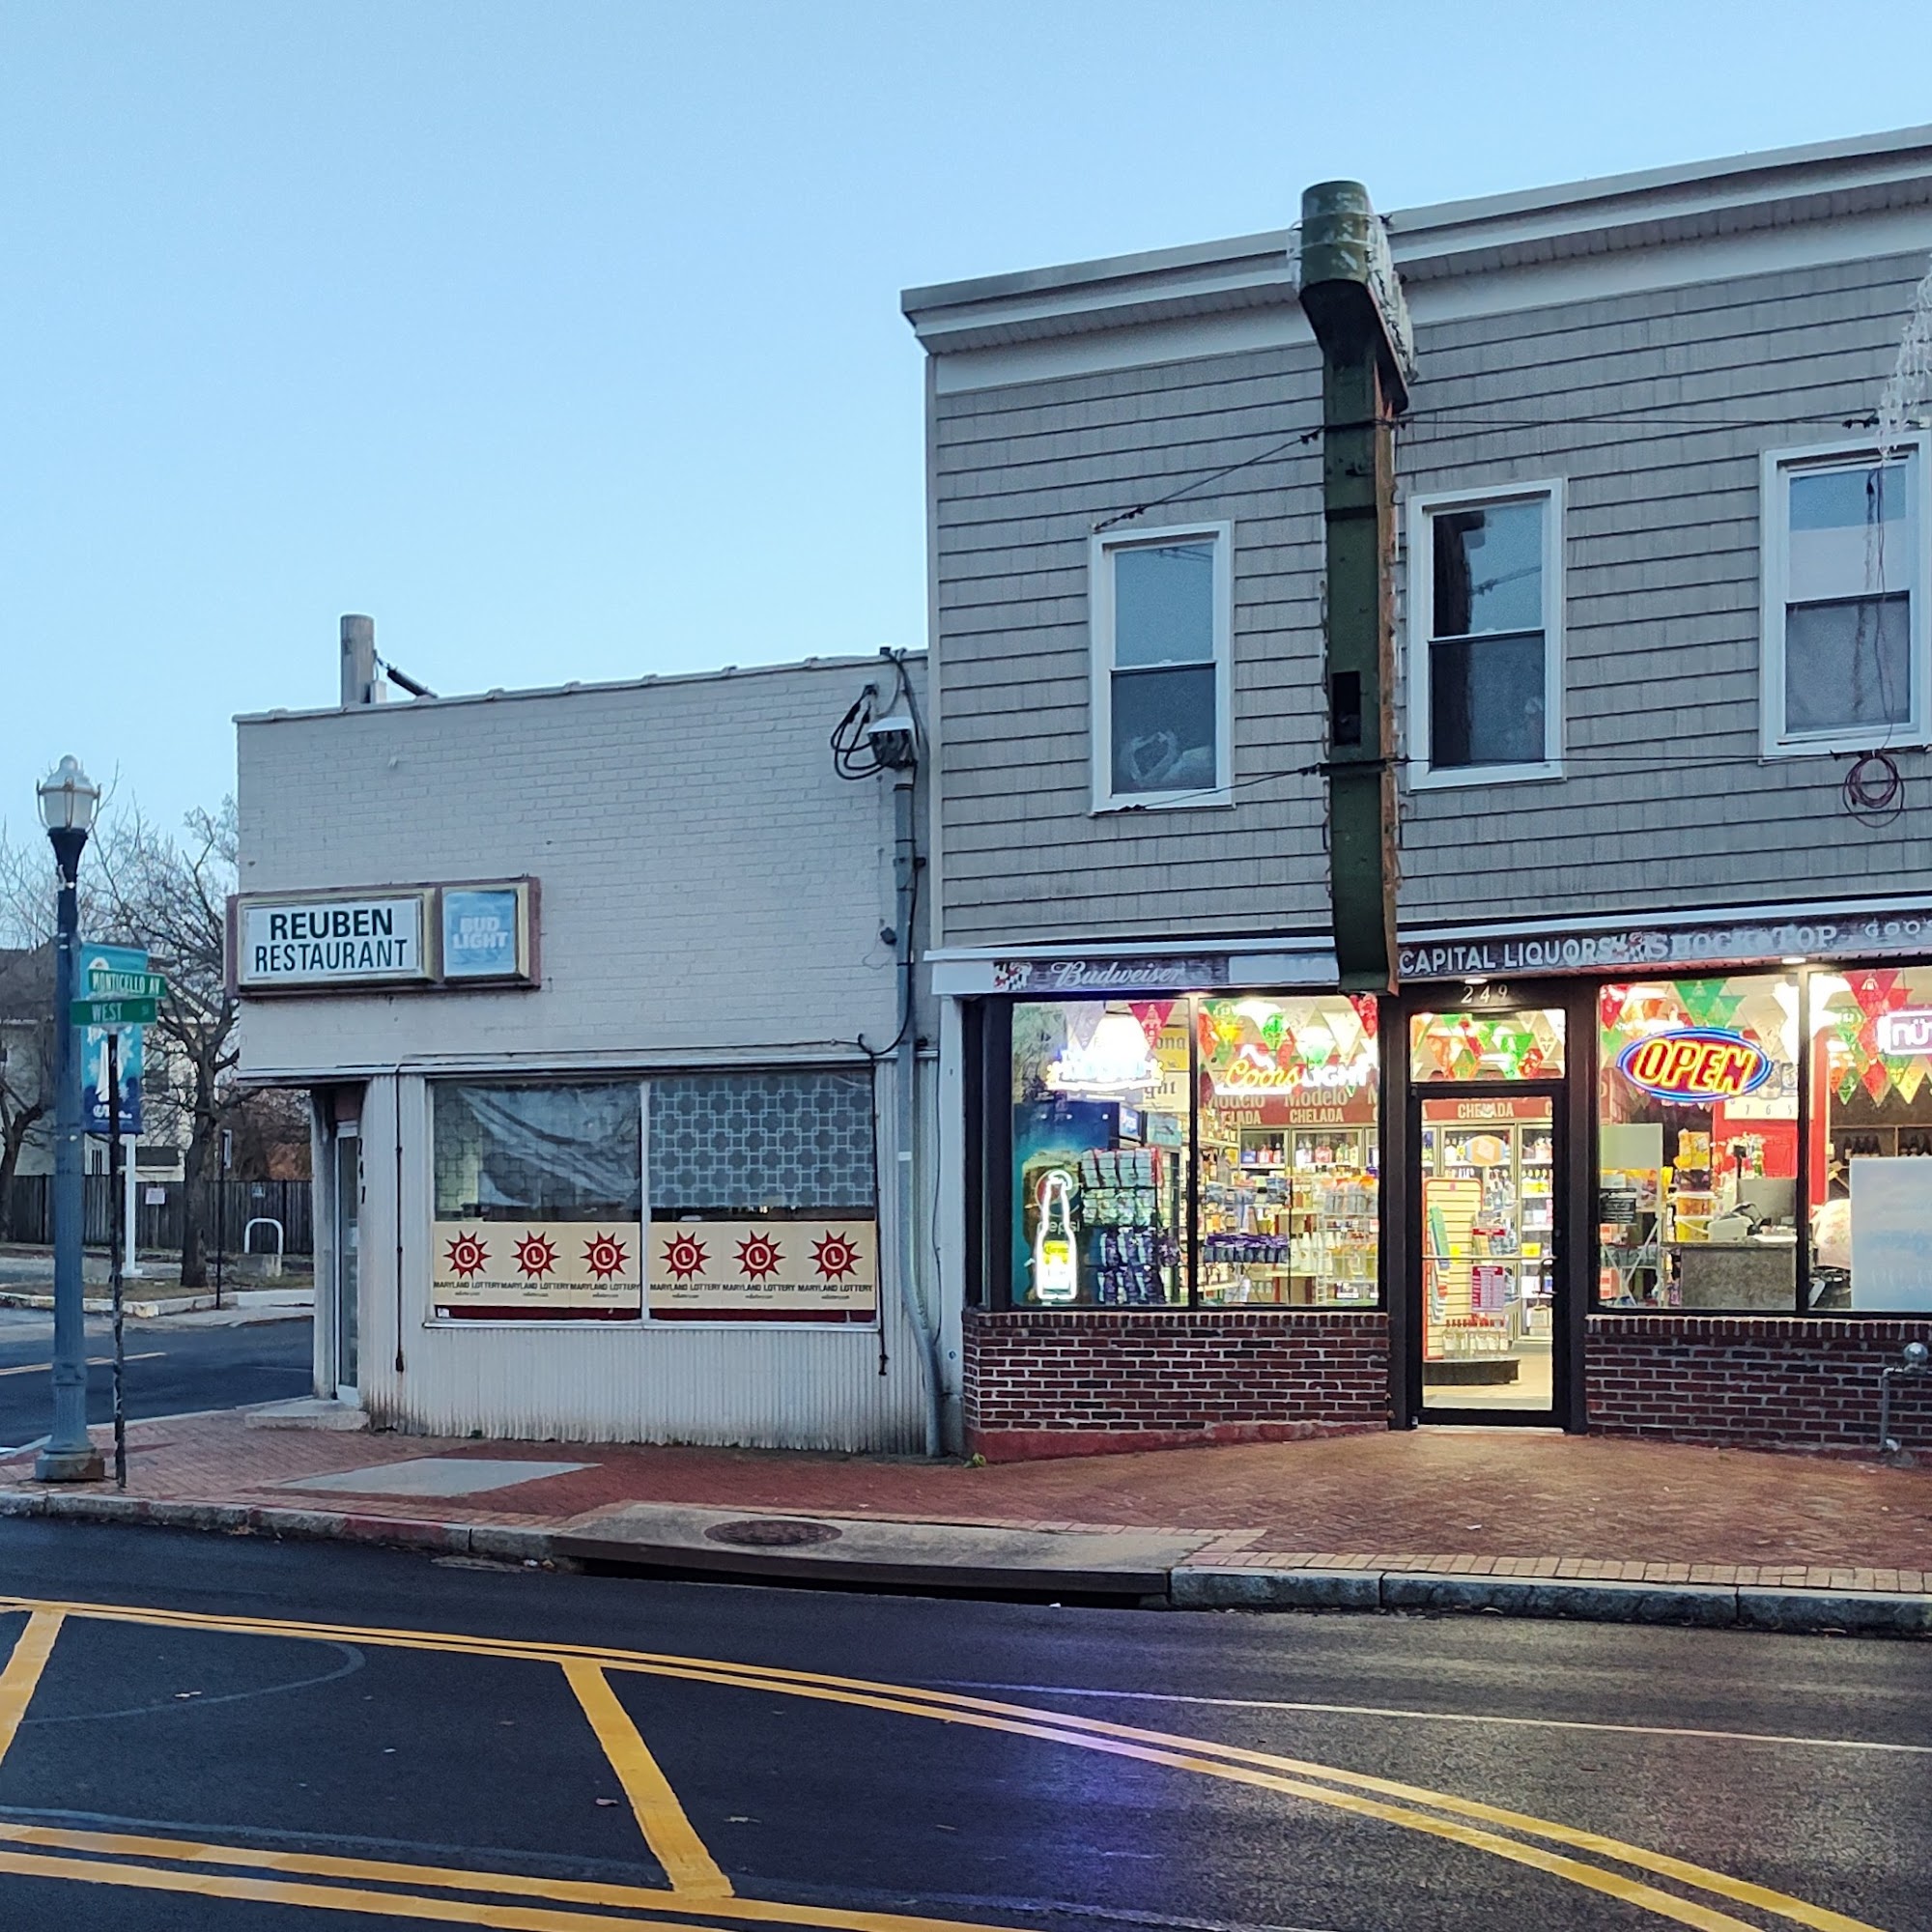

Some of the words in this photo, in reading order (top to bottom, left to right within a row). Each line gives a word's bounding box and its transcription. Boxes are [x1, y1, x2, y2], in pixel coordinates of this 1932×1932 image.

[270, 908, 393, 940] REUBEN
[460, 917, 499, 933] BUD
[453, 931, 508, 949] LIGHT
[1645, 929, 1757, 959] SHOCK
[1772, 924, 1836, 951] TOP
[255, 939, 407, 972] RESTAURANT
[1399, 945, 1496, 975] CAPITAL
[1505, 937, 1612, 967] LIQUORS
[93, 972, 145, 995] MONTICELLO
[149, 977, 160, 995] AV
[1051, 960, 1186, 988] Budweiser
[1461, 984, 1508, 1004] 249
[92, 1003, 123, 1022] WEST
[1225, 1059, 1300, 1089] Coors
[1301, 1063, 1370, 1088] LIGHT
[1634, 1037, 1757, 1095] OPEN
[1284, 1084, 1348, 1109] Modelo
[1290, 1107, 1345, 1124] CHELADA
